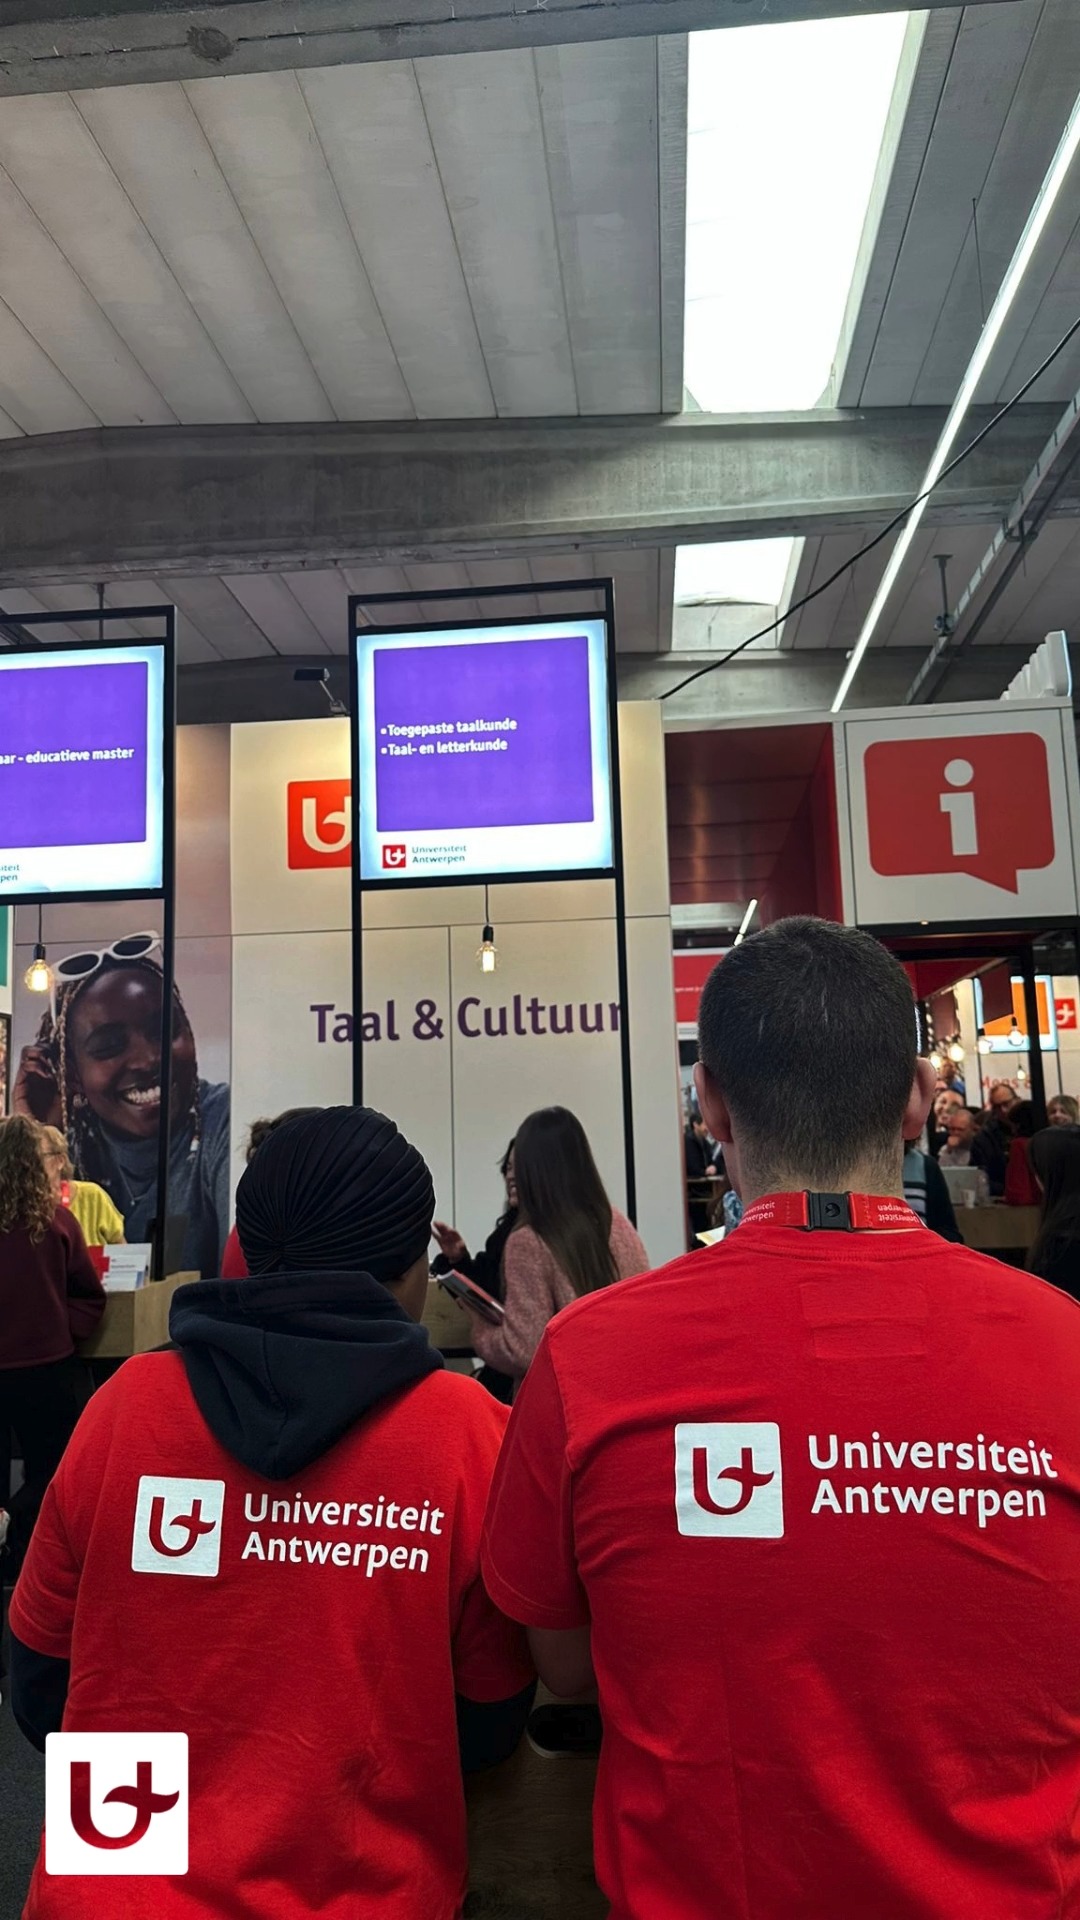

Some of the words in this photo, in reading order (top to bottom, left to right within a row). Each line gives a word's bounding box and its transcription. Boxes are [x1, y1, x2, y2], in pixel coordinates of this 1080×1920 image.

[387, 722, 454, 738] Toegepaste
[456, 718, 517, 733] taalkunde
[25, 749, 91, 763] educatieve
[92, 748, 135, 760] master
[387, 742, 417, 756] Taal-
[419, 744, 434, 755] en
[437, 738, 508, 753] letterkunde
[411, 845, 467, 854] Universiteit
[412, 855, 465, 865] Antwerpen
[310, 999, 400, 1043] Taal
[412, 998, 445, 1041] &
[457, 994, 621, 1038] Cultuur
[808, 1431, 1059, 1479] Universiteit
[244, 1492, 445, 1535] Universiteit
[811, 1478, 1047, 1528] Antwerpen
[241, 1531, 429, 1578] Antwerpen
